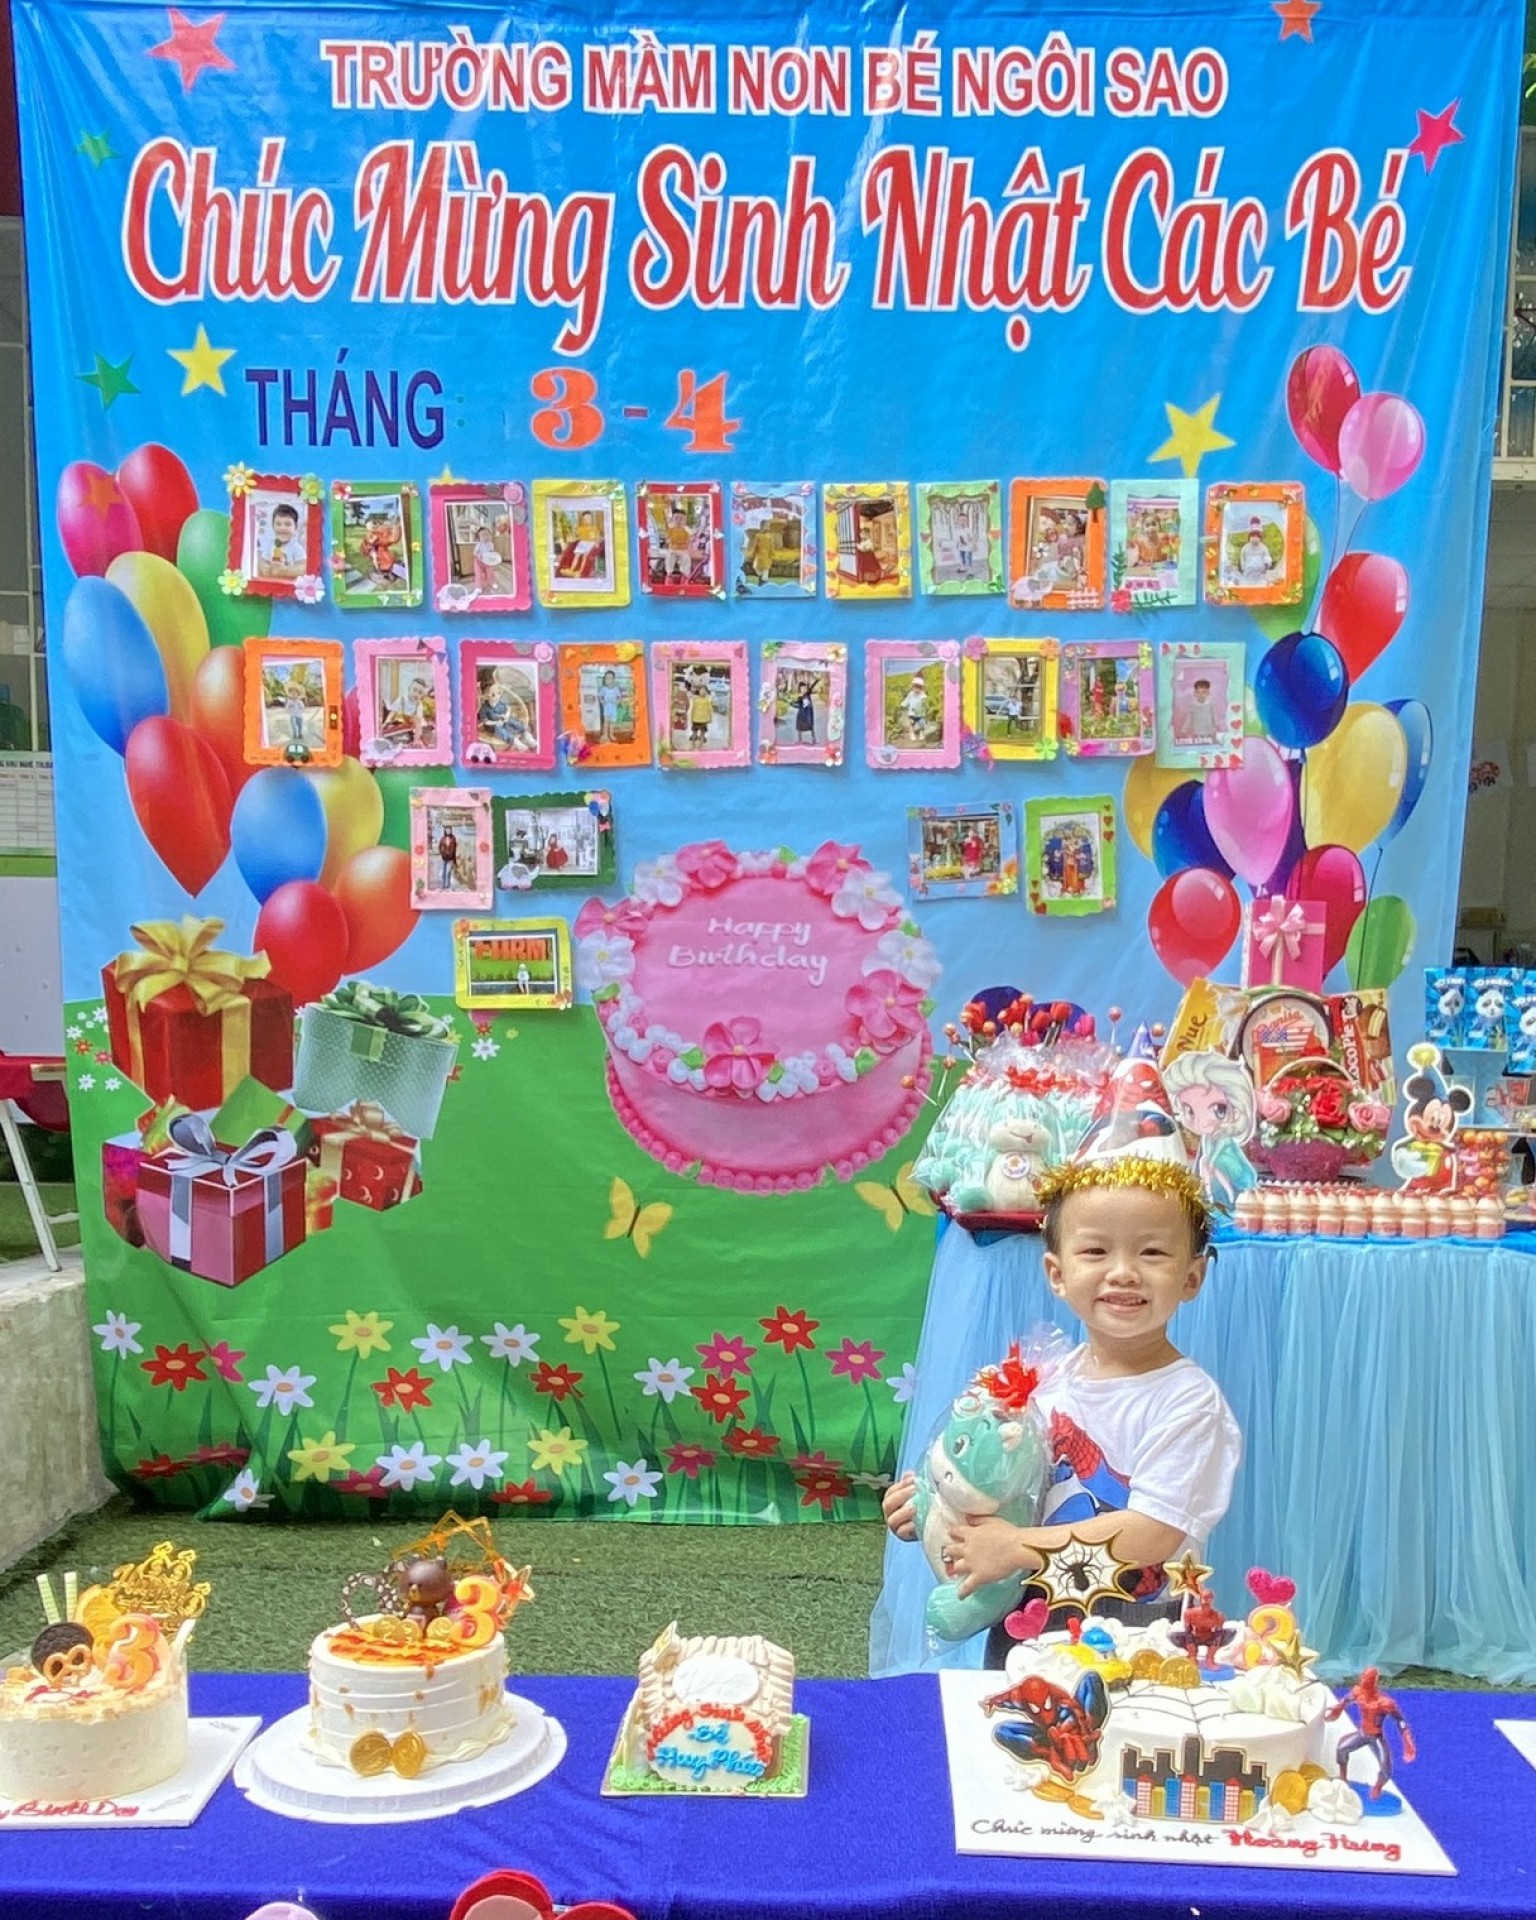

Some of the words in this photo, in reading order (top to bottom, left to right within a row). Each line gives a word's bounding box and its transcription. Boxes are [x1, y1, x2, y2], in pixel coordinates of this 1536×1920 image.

[321, 25, 570, 112] TRƯỜNG
[585, 31, 718, 114] MẦM
[729, 43, 851, 115] NON
[863, 37, 942, 116] BÉ
[952, 32, 1096, 117] NGÔI
[1105, 47, 1229, 118] SAO
[122, 136, 342, 303] Chúc
[351, 140, 616, 357] Mừng
[629, 143, 850, 310] Sinh
[862, 146, 1094, 353] Nhật
[1101, 147, 1274, 315] Các
[1285, 147, 1413, 315] Bé
[244, 347, 444, 451] THÁNG
[530, 366, 604, 451] 3
[664, 367, 743, 453] 4
[668, 943, 829, 988] Birthday
[708, 916, 812, 947] Happy
[448, 1575, 499, 1648] 3
[103, 1612, 161, 1690] 3
[970, 1818, 1033, 1834] Chúc
